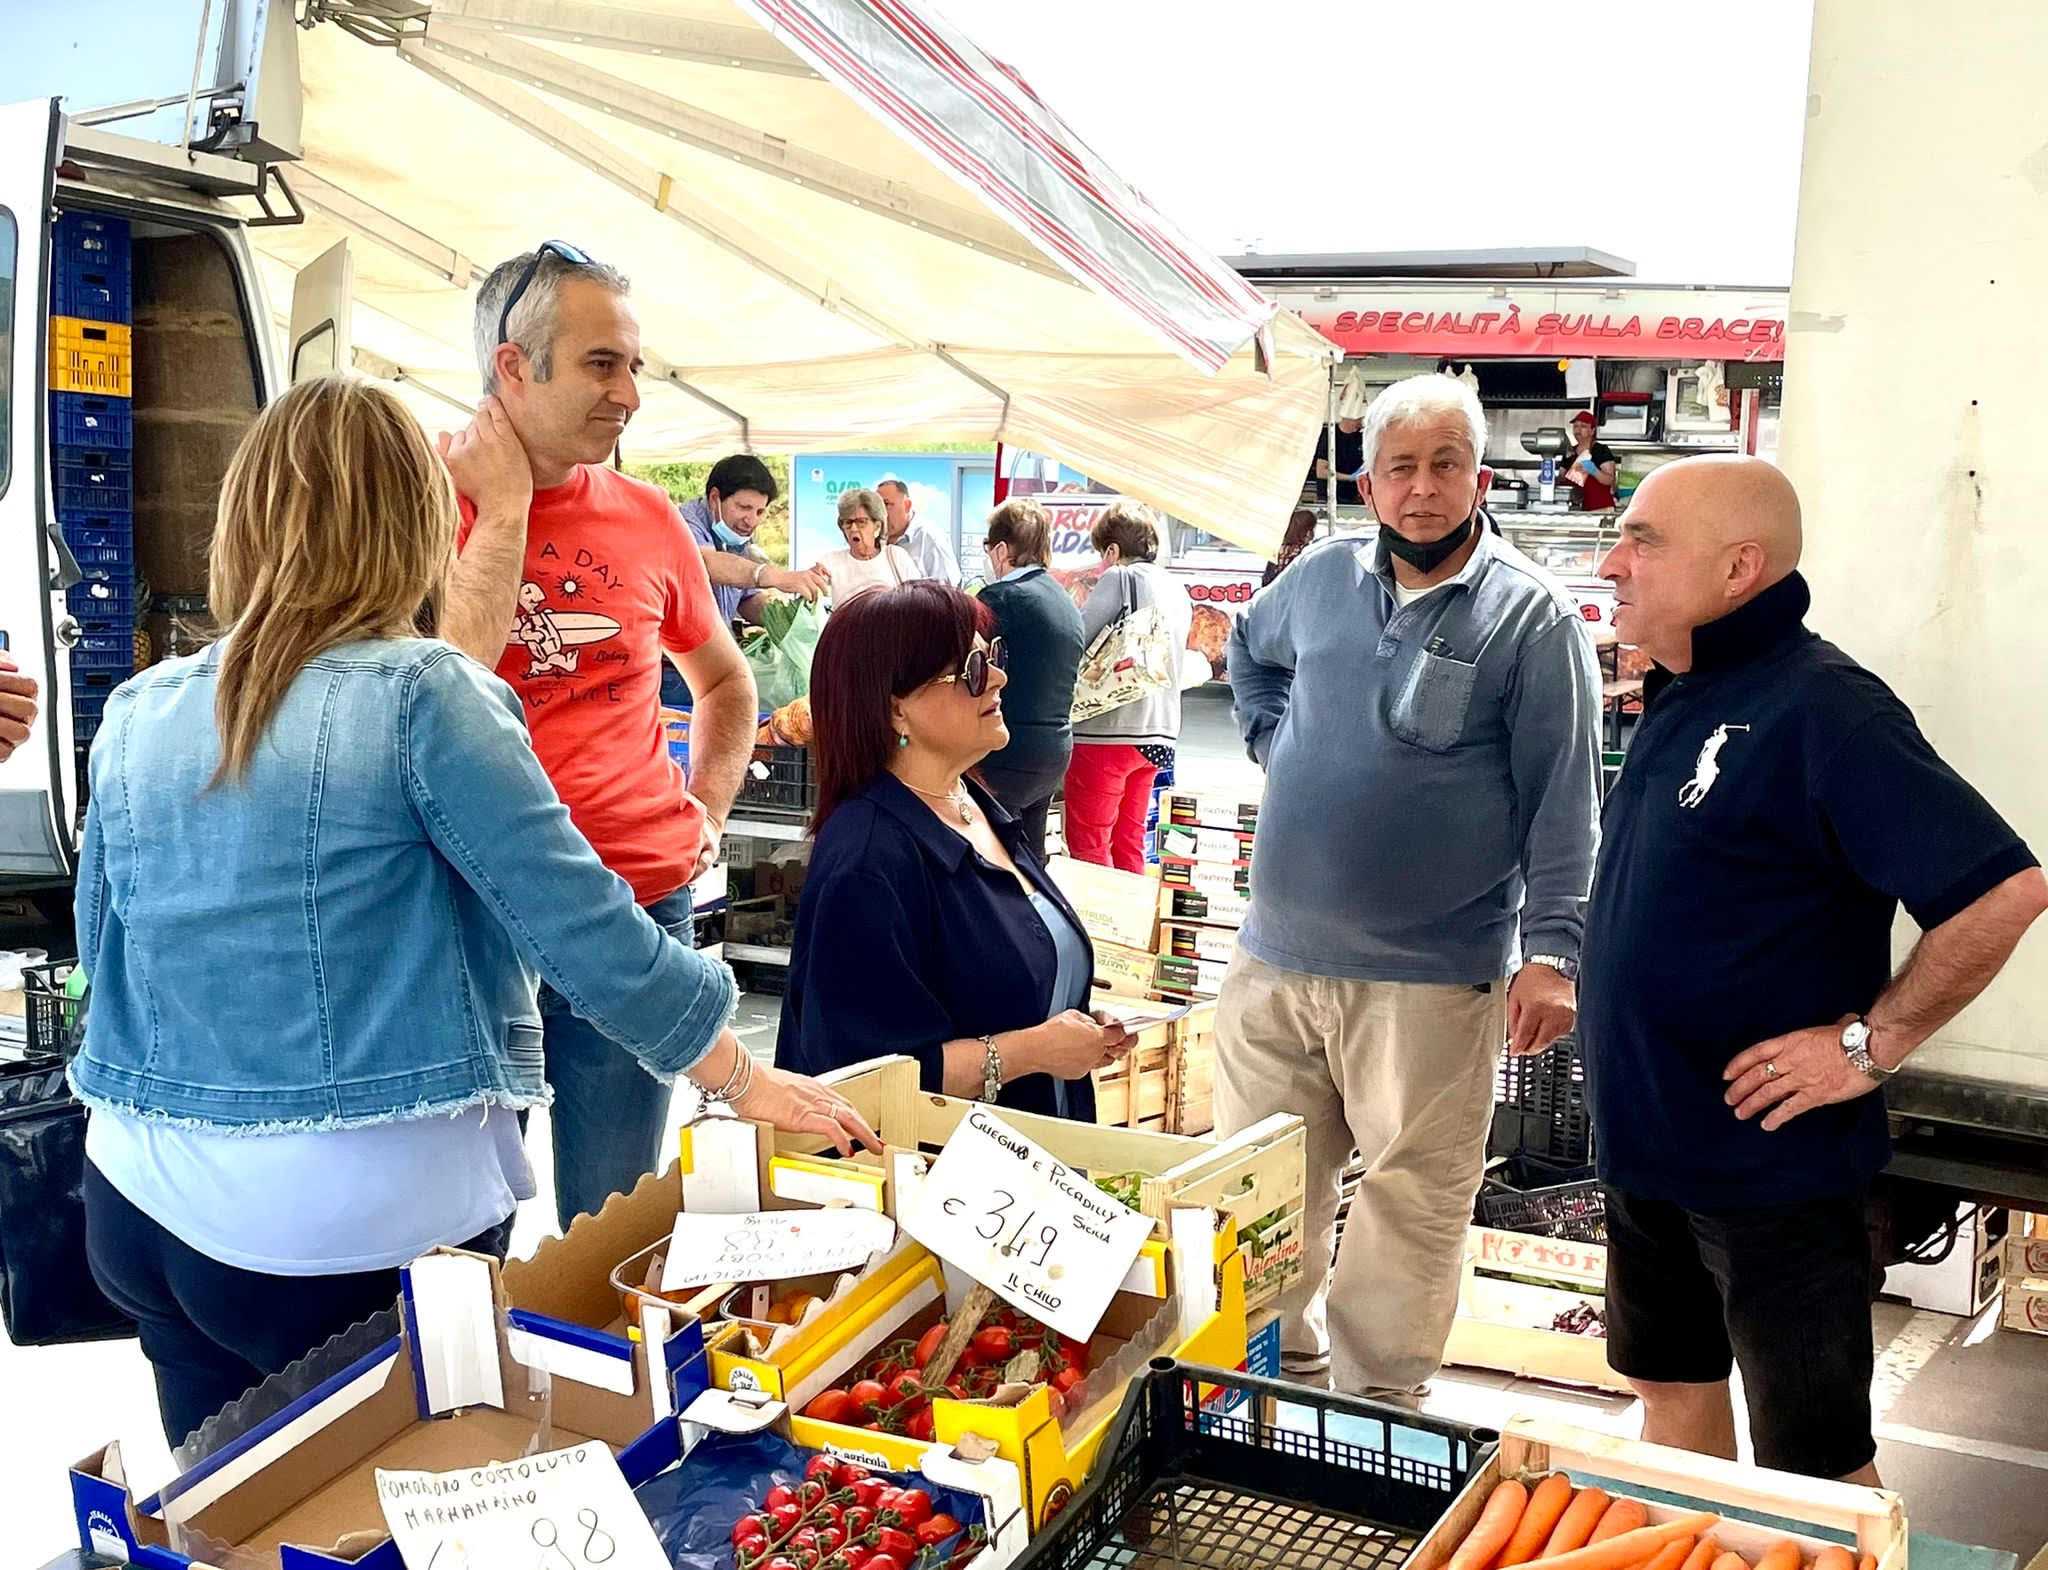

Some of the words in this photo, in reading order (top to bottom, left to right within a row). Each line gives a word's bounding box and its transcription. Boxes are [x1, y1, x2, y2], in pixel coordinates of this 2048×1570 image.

[1334, 303, 1521, 334] SPECIALITÀ
[1535, 313, 1642, 338] SULLA
[1656, 316, 1784, 343] BRACE!
[540, 542, 560, 559] A
[575, 549, 624, 590] DAY
[1184, 582, 1253, 603] osti
